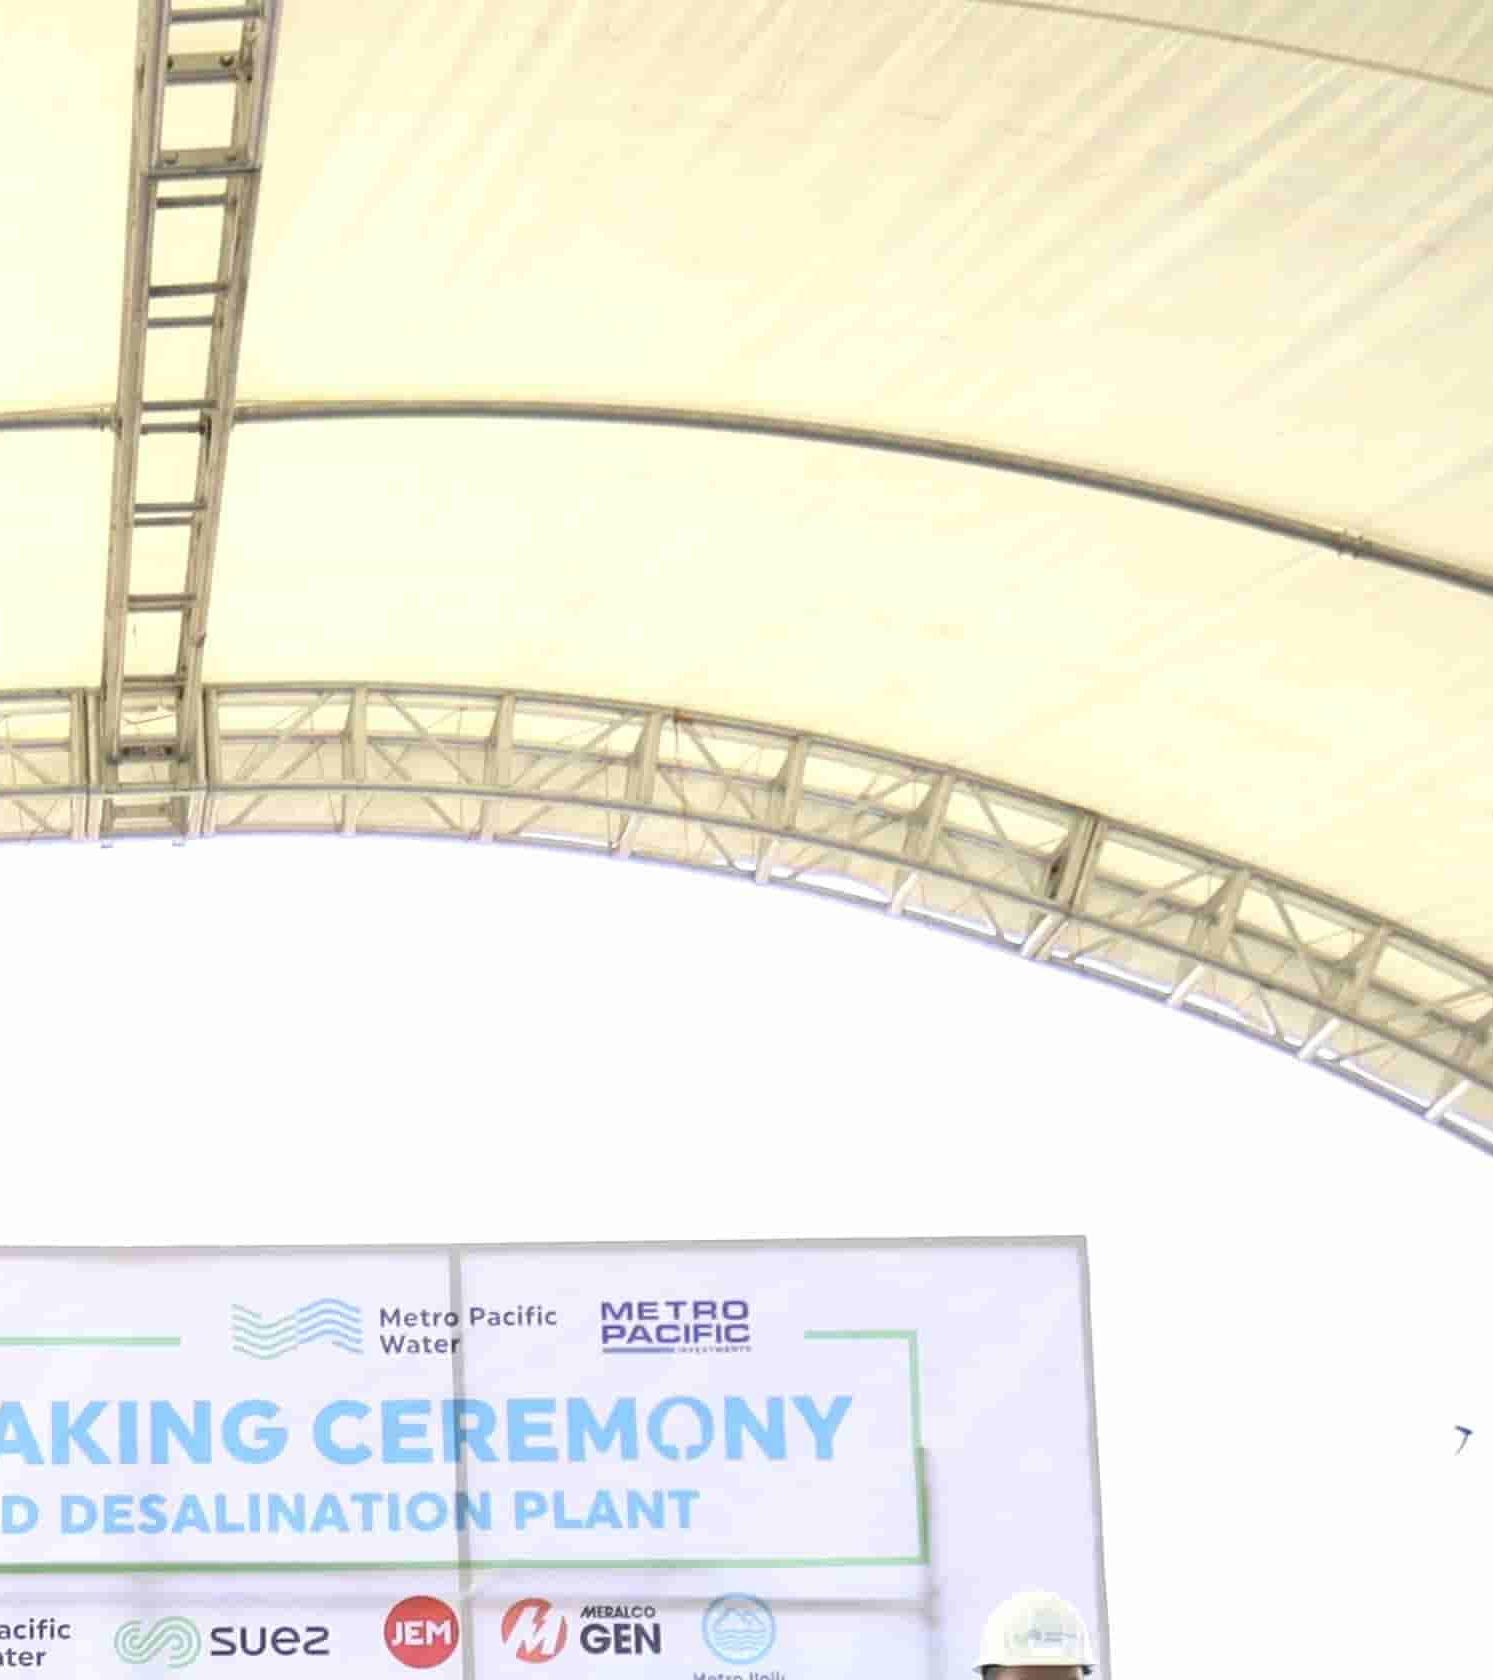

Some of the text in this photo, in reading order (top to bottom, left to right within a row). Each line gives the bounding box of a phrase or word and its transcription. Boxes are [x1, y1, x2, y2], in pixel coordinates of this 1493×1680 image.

[379, 1305, 558, 1328] Metro Pacific
[600, 1299, 750, 1321] METRO
[379, 1334, 462, 1355] Water
[601, 1323, 752, 1345] PACIFIC
[313, 1395, 853, 1465] CEREMONY
[60, 1490, 492, 1534] DESALINATION
[514, 1488, 701, 1531] PLANT
[580, 1605, 656, 1619] MERALCO
[210, 1625, 330, 1657] suez
[387, 1621, 454, 1646] JEM
[580, 1622, 662, 1655] GEN
